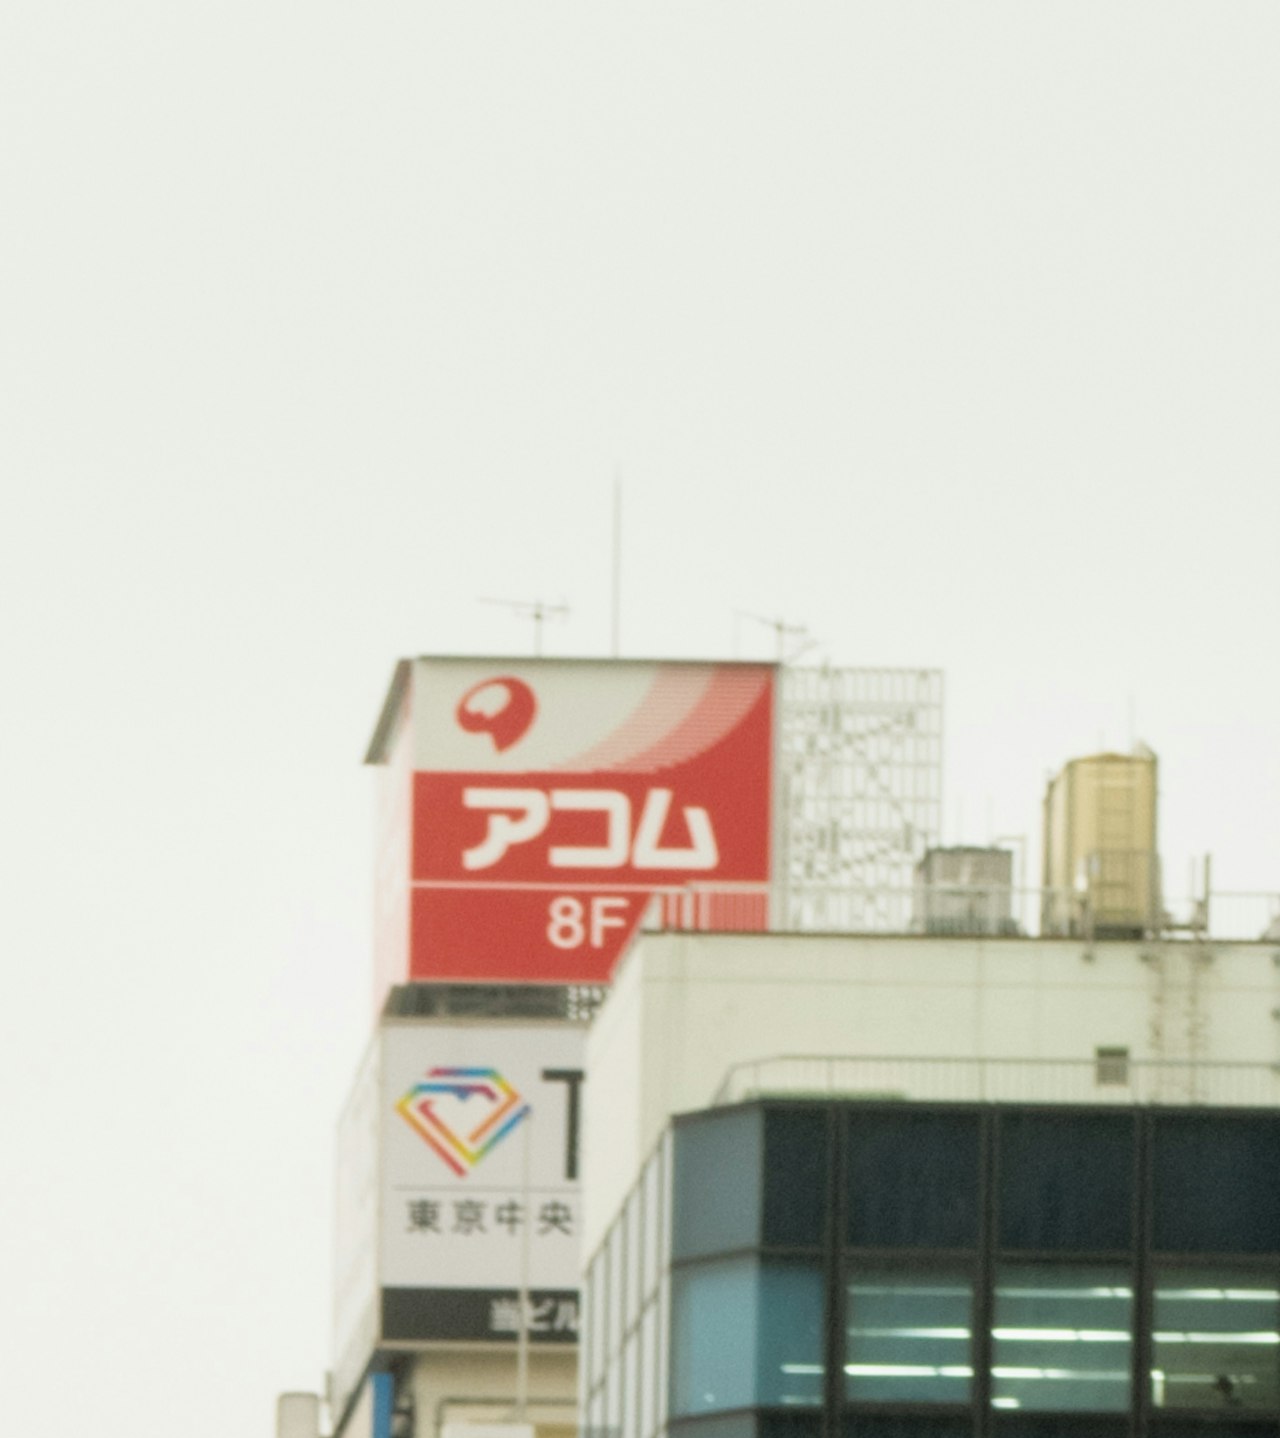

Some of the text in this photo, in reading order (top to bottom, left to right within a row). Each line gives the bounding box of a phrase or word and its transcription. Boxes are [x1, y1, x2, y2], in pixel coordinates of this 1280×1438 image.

[461, 787, 719, 871] アコム
[546, 896, 631, 949] 8F
[541, 1068, 586, 1180] T
[405, 1200, 575, 1237] 東京中央
